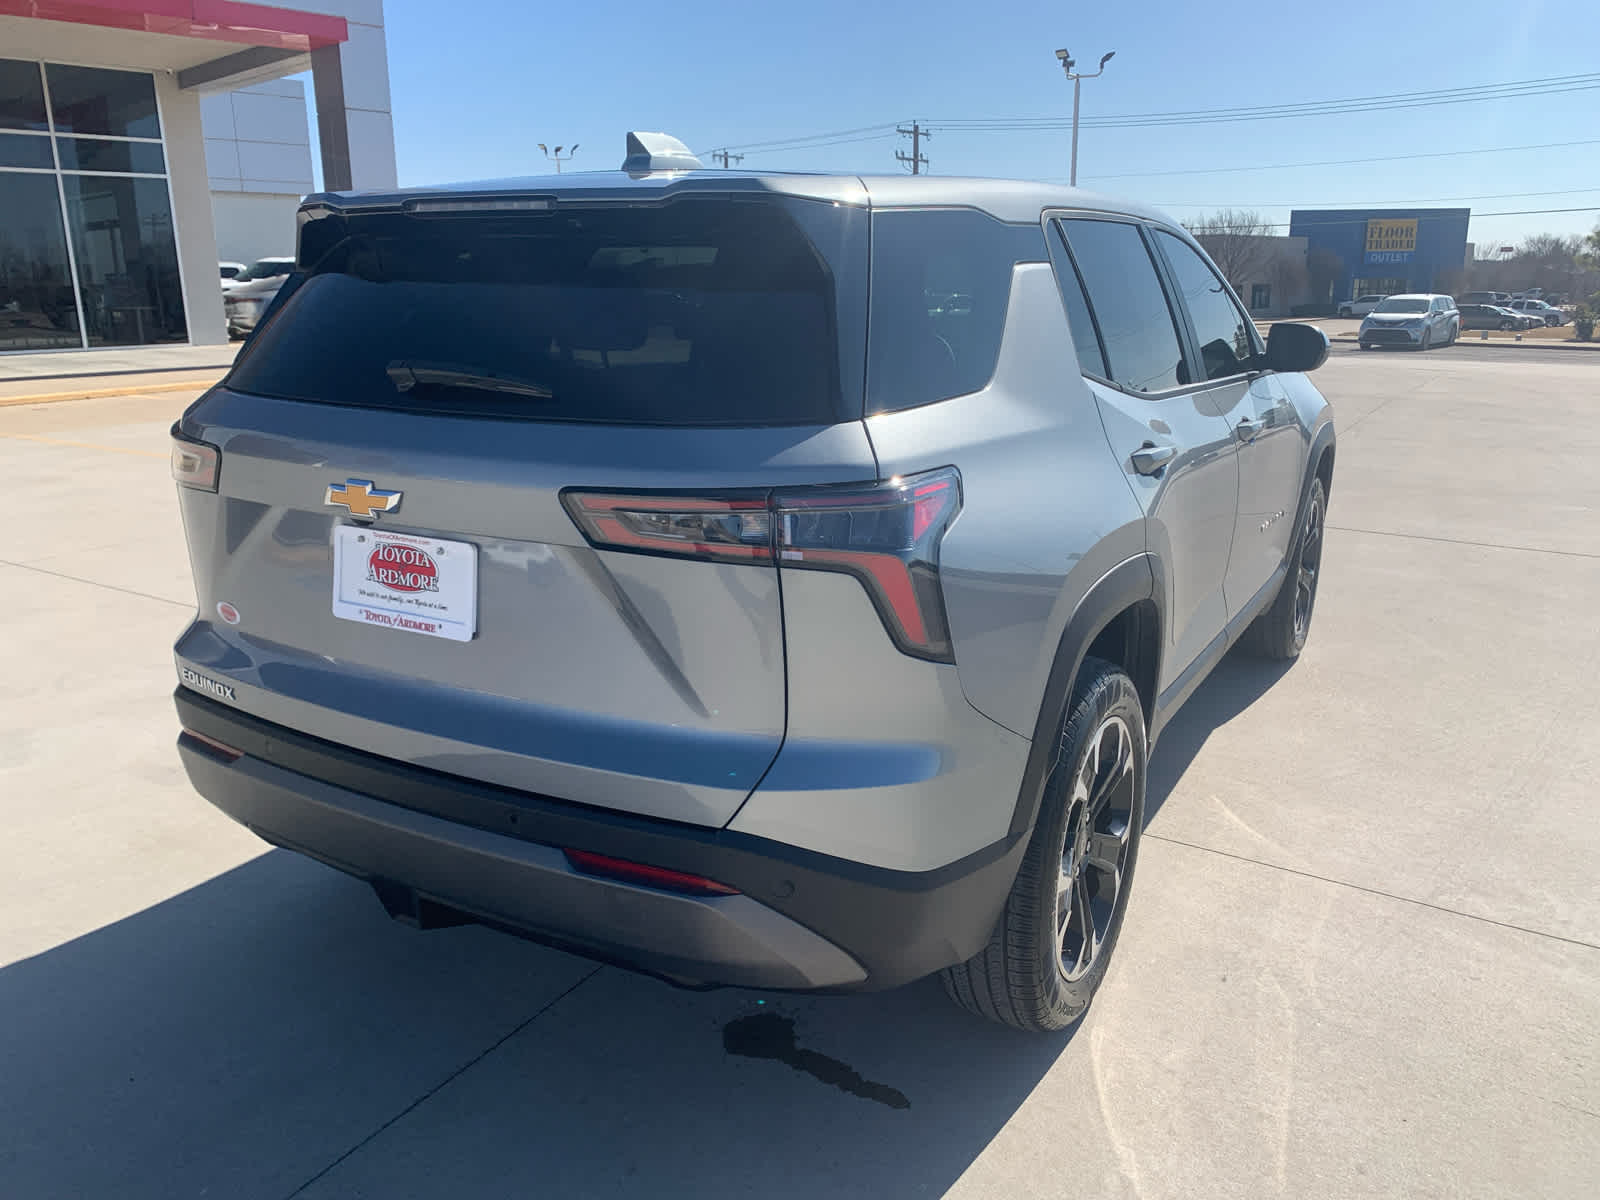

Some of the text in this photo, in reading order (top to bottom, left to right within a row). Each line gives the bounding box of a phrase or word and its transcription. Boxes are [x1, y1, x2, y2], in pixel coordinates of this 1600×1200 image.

[1369, 225, 1415, 239] FLOOR
[1370, 253, 1409, 263] OUTLET
[375, 542, 431, 568] TOYOTA
[367, 564, 439, 592] ARDMORE
[363, 609, 392, 625] TOYOTA
[397, 615, 436, 633] ARDMORE
[183, 667, 235, 701] EQUINOX
